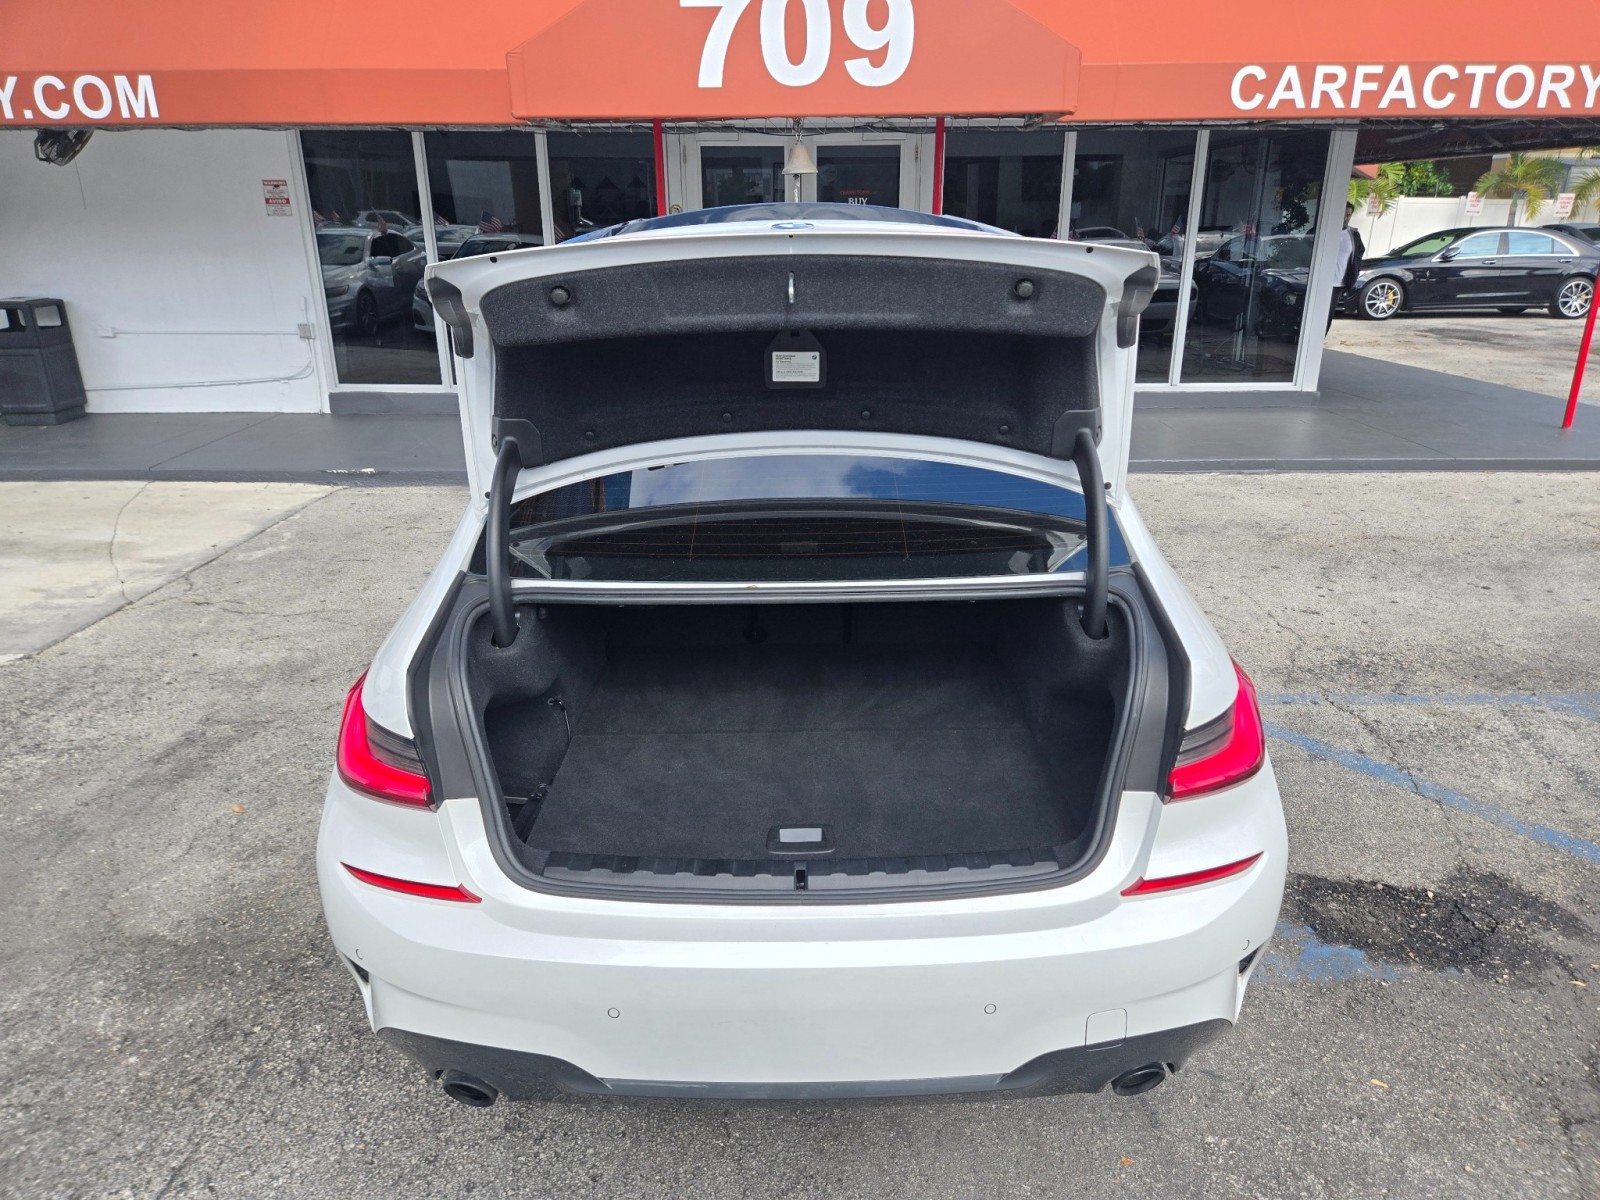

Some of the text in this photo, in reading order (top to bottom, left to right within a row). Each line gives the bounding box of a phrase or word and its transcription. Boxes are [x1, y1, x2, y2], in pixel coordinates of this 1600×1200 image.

[679, 0, 915, 88] 709
[0, 74, 160, 120] Y.COM
[848, 197, 868, 205] BUY
